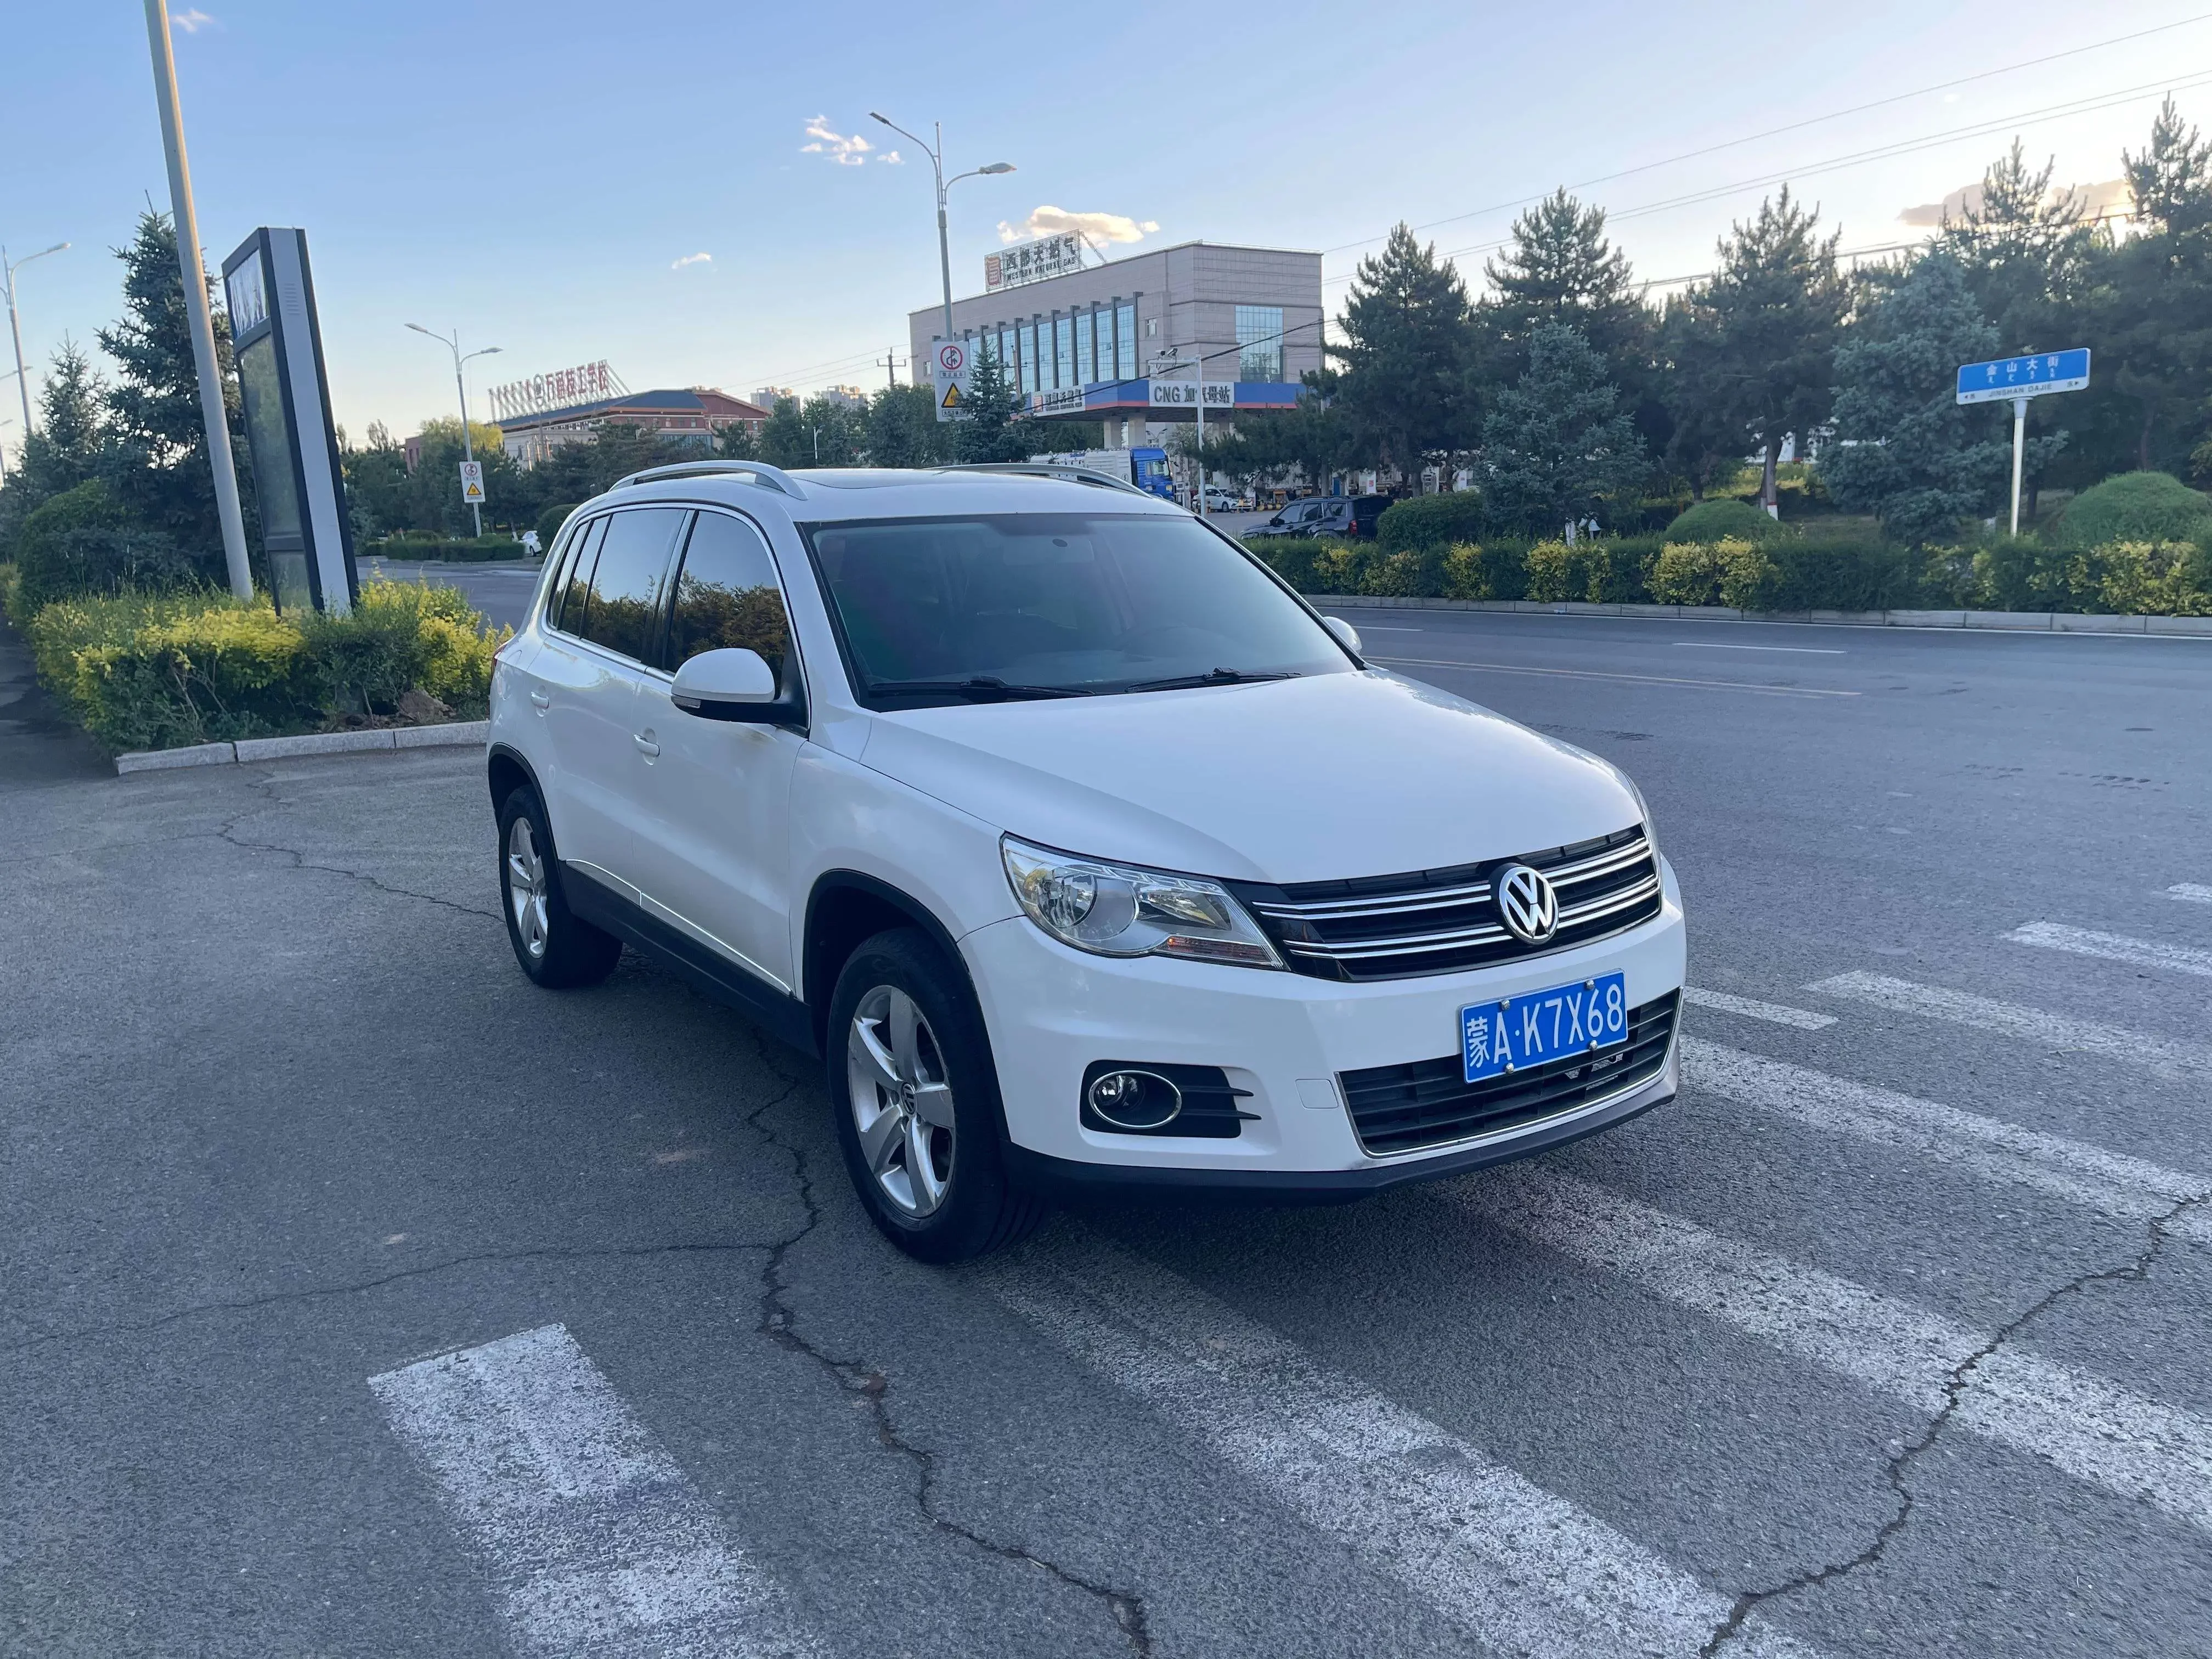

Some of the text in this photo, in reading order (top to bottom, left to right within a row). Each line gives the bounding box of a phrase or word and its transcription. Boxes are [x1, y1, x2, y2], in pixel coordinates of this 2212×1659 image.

[1986, 356, 2059, 376] 金山大街
[1154, 386, 1180, 403] CNG
[1989, 383, 2052, 397] JINSHAN DAJIE
